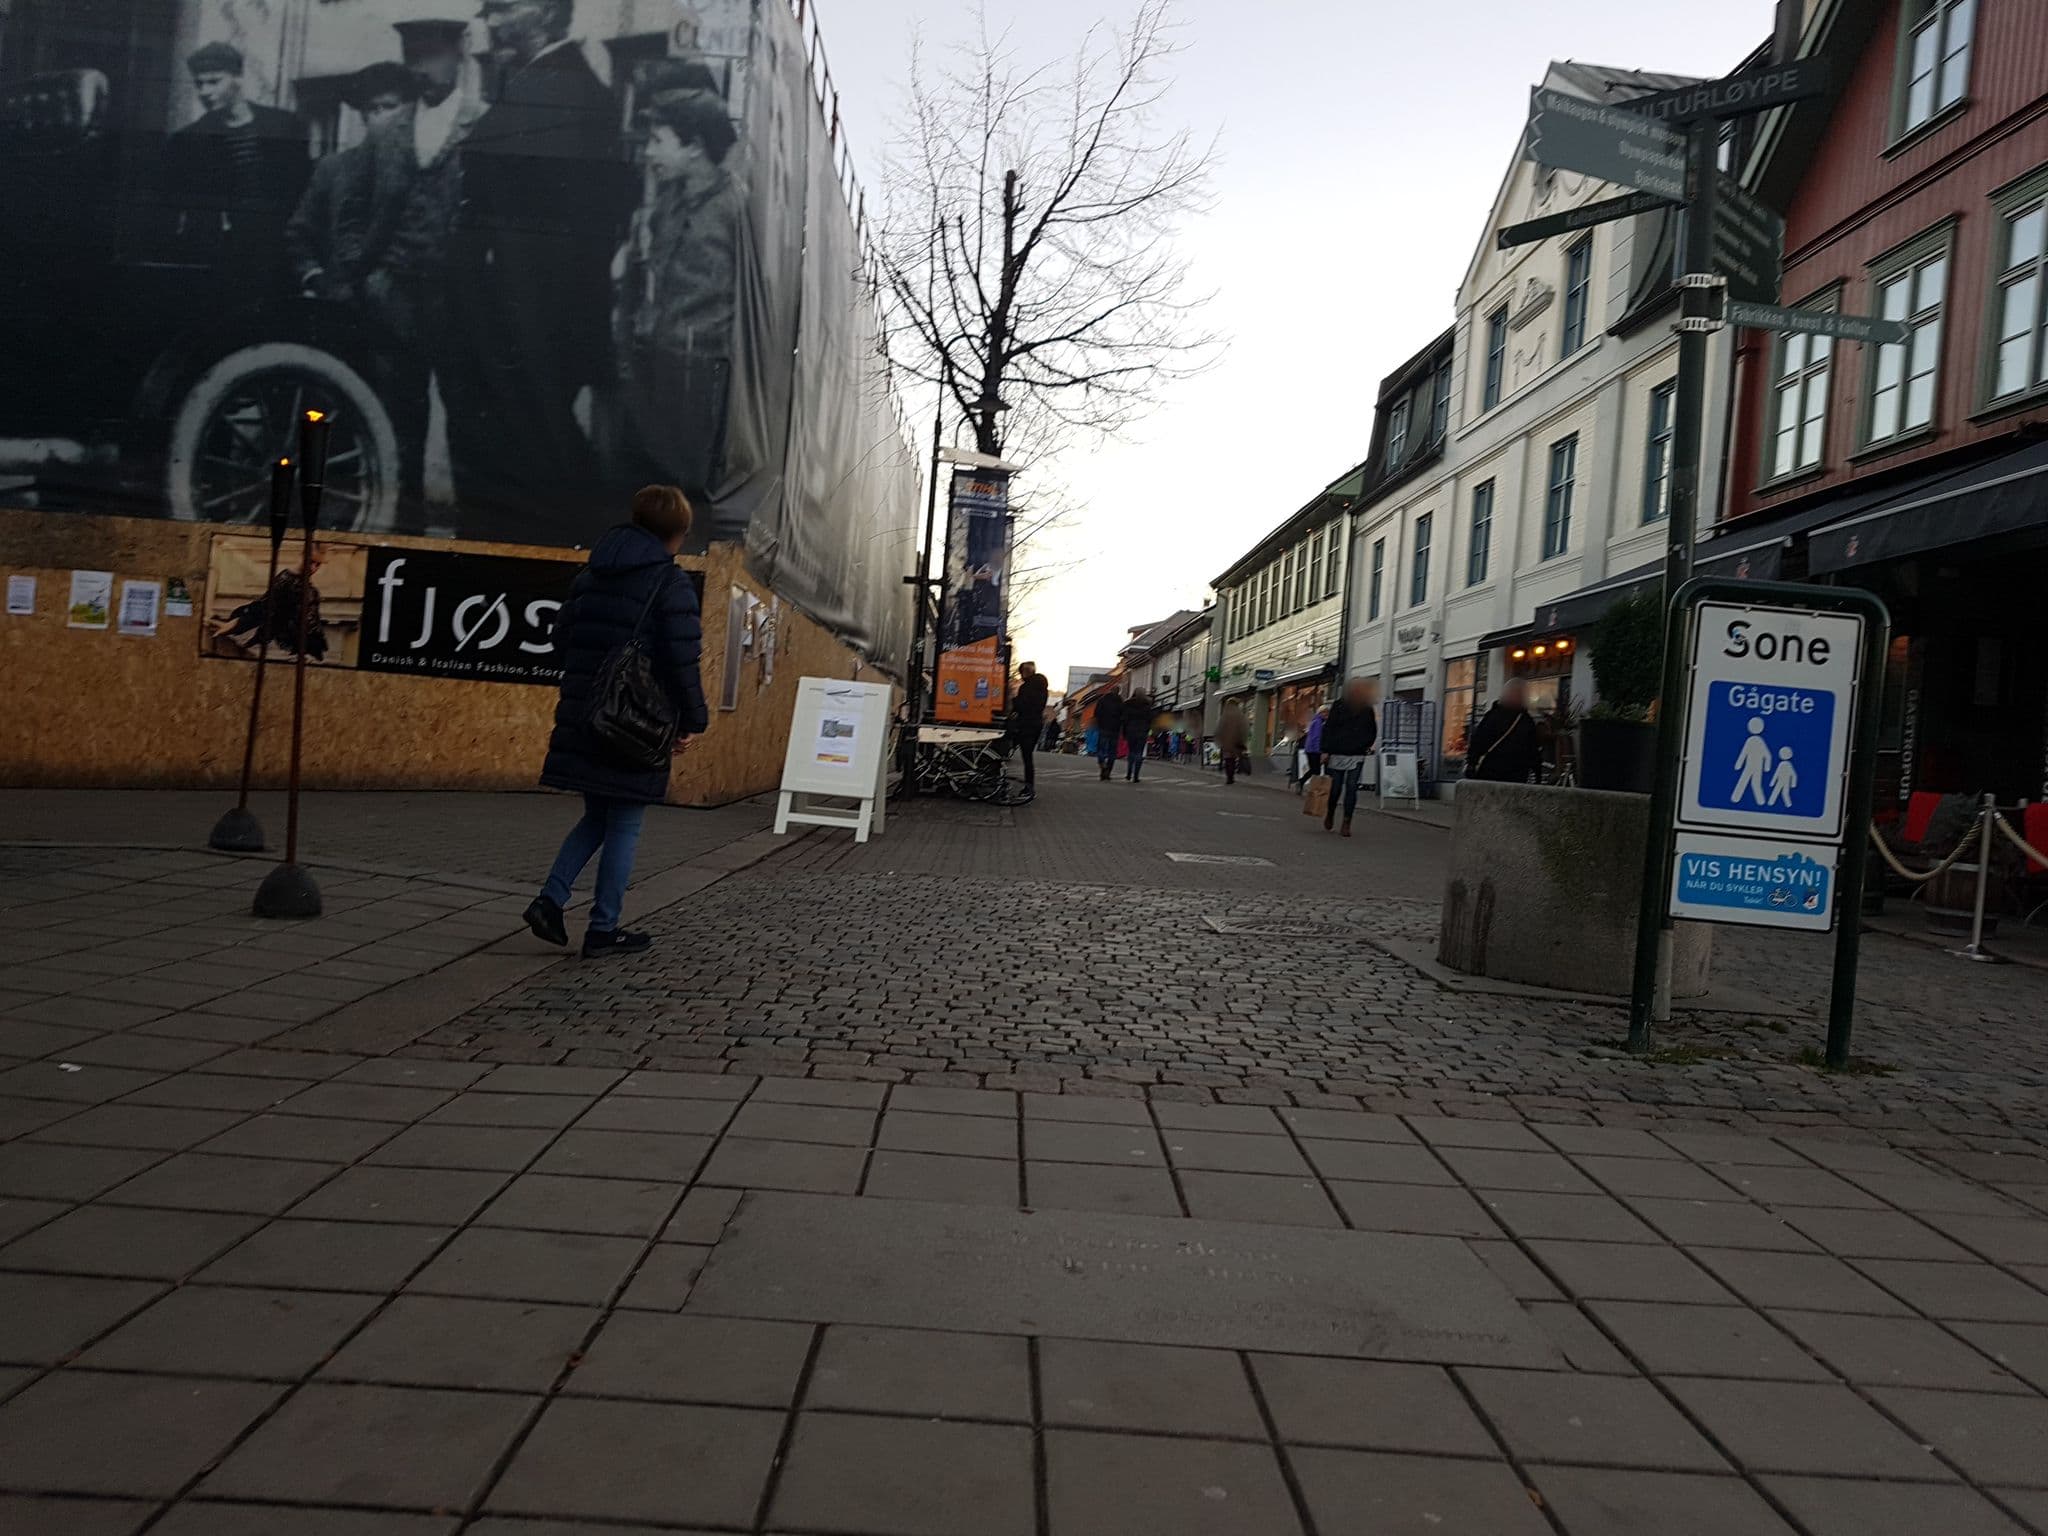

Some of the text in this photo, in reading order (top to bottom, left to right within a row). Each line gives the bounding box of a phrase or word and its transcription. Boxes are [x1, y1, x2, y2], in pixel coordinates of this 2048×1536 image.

[1723, 619, 1831, 666] Sone
[371, 652, 414, 666] Danish
[418, 657, 427, 667] &
[432, 658, 472, 670] Italian
[1728, 684, 1816, 716] Gågate
[1685, 878, 1764, 895] NÅR DU SYKLER
[1687, 859, 1822, 887] VIS HENSYN!
